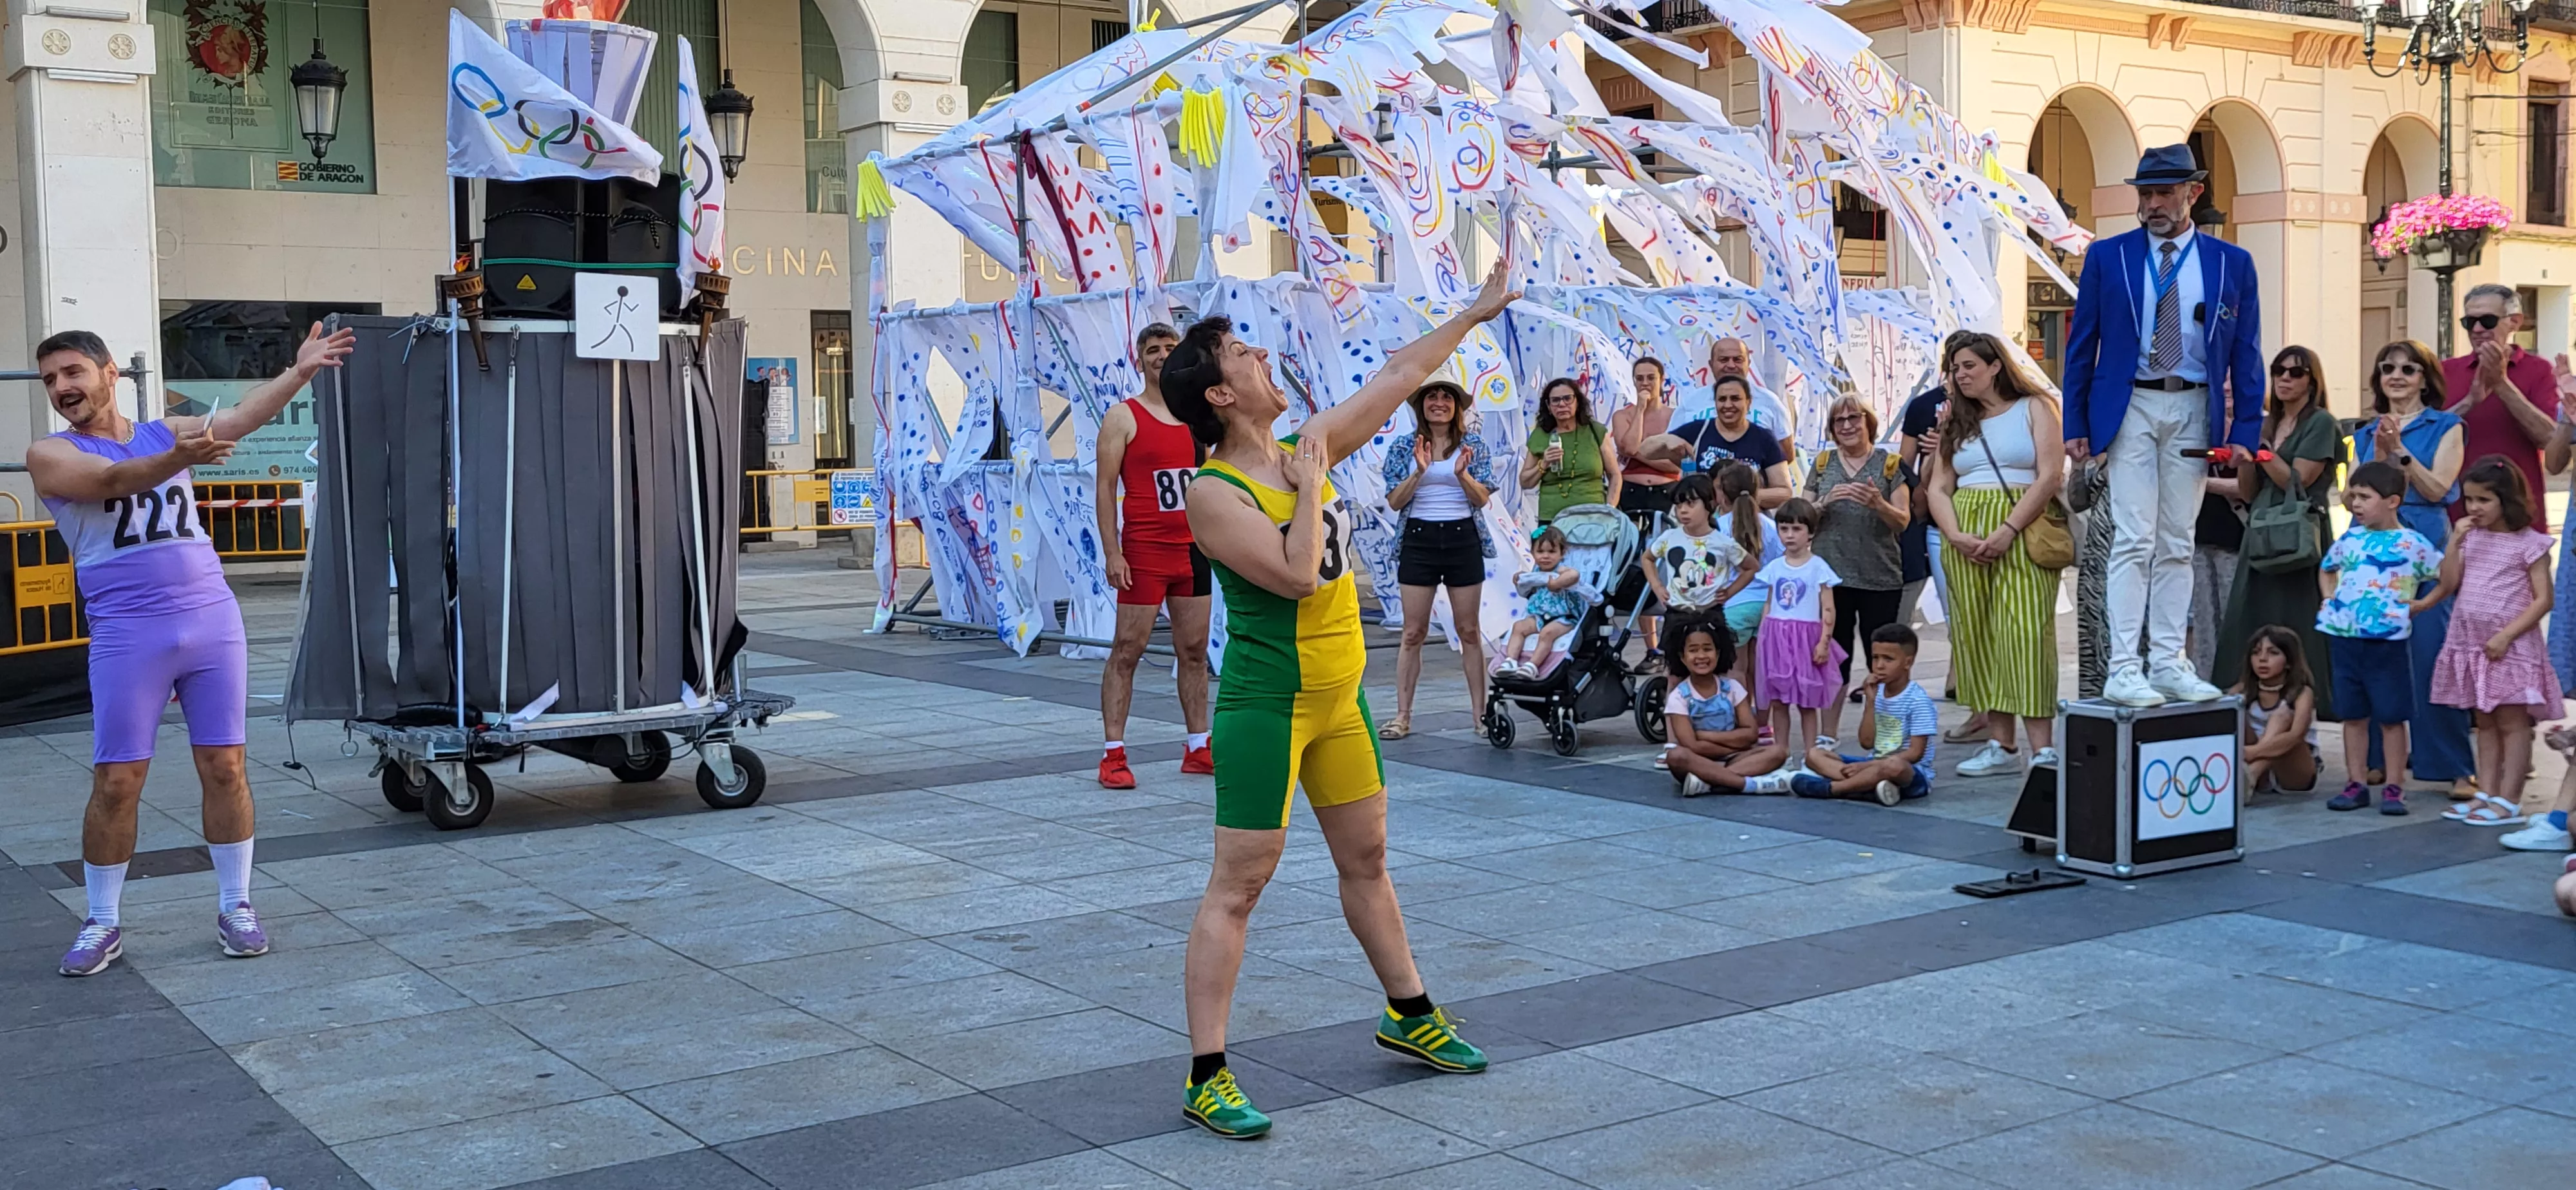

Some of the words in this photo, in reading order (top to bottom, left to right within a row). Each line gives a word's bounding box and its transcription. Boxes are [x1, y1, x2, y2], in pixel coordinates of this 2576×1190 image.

[298, 162, 356, 173] GOBIERNO
[299, 172, 314, 181] DE
[317, 173, 365, 184] ARAGON
[732, 245, 838, 276] CINA
[198, 468, 260, 477] www.saris.es
[283, 466, 299, 474] 974
[104, 485, 195, 550] 222
